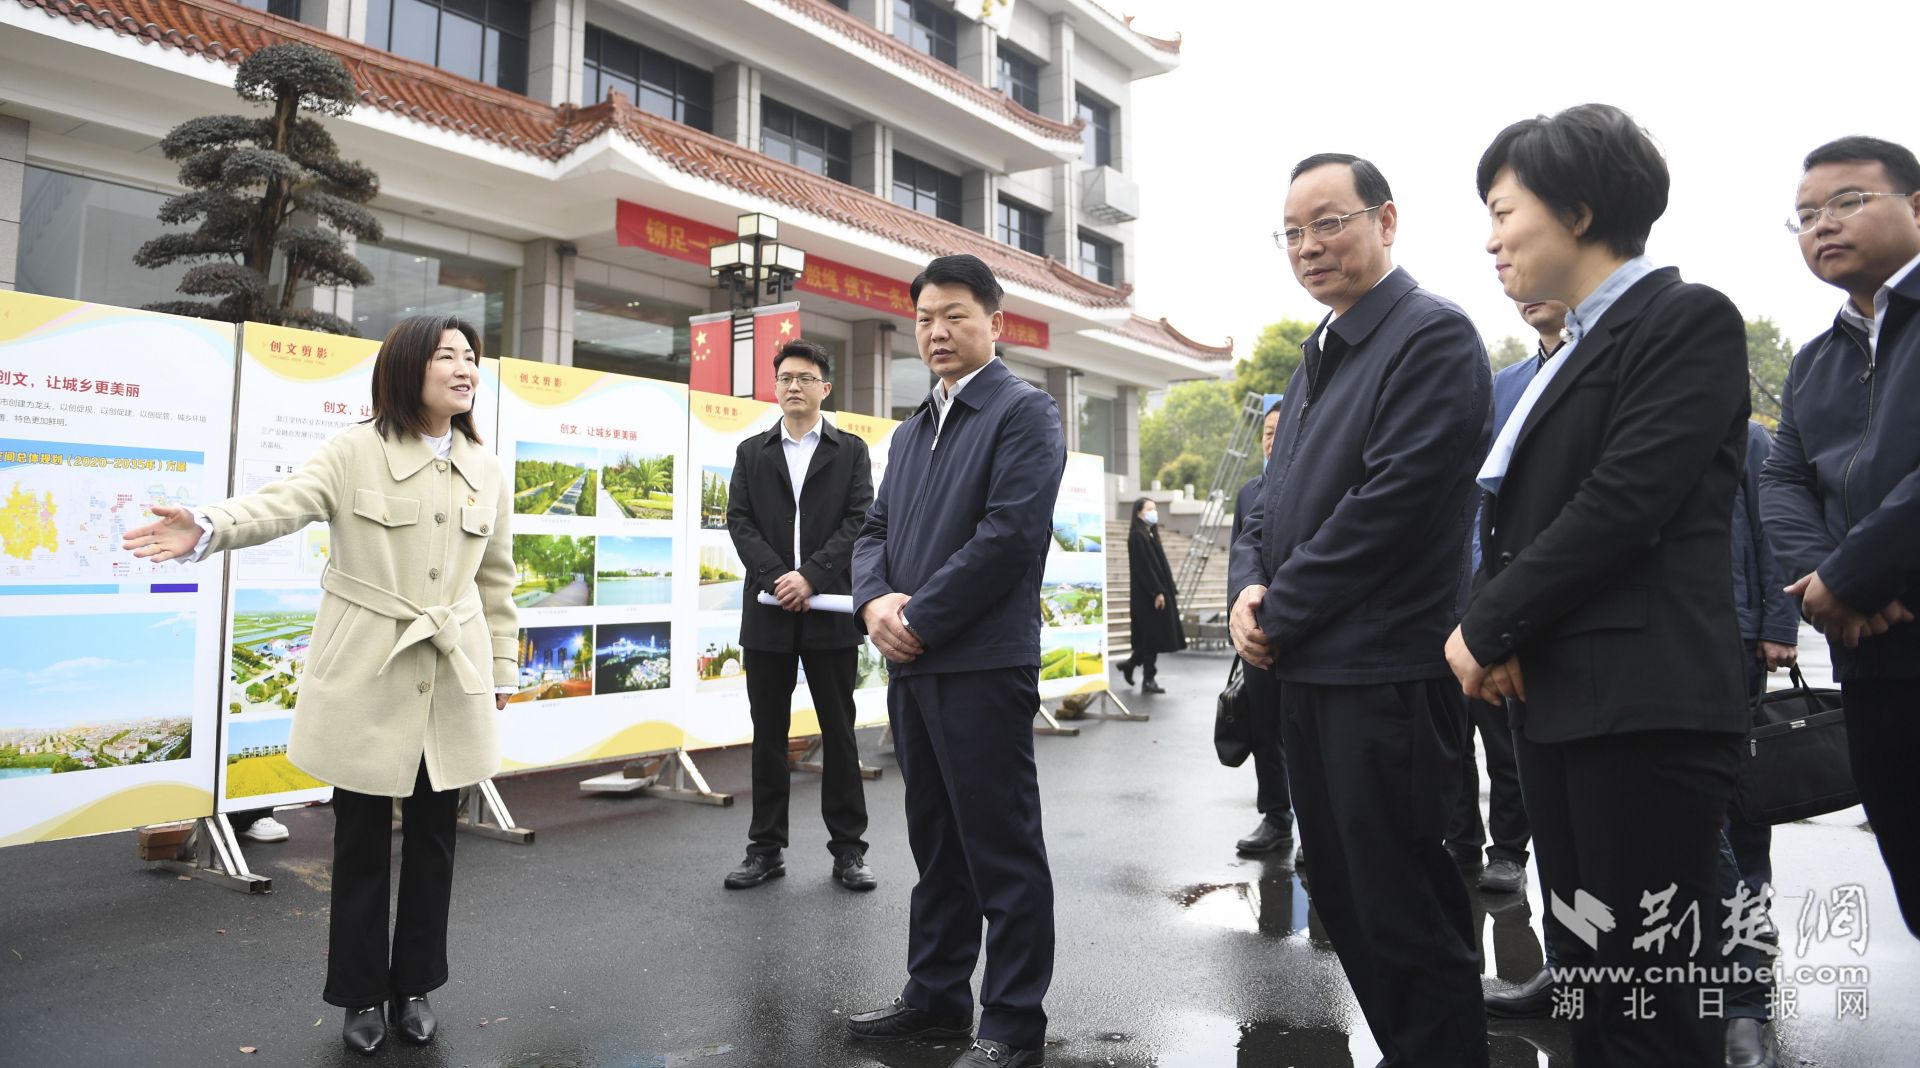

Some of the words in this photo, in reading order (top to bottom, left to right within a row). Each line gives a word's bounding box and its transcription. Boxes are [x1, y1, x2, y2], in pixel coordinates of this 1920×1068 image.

[270, 340, 328, 359] 创文剪影
[0, 369, 141, 398] 创文，让城乡更美丽
[519, 372, 563, 388] 创文剪影
